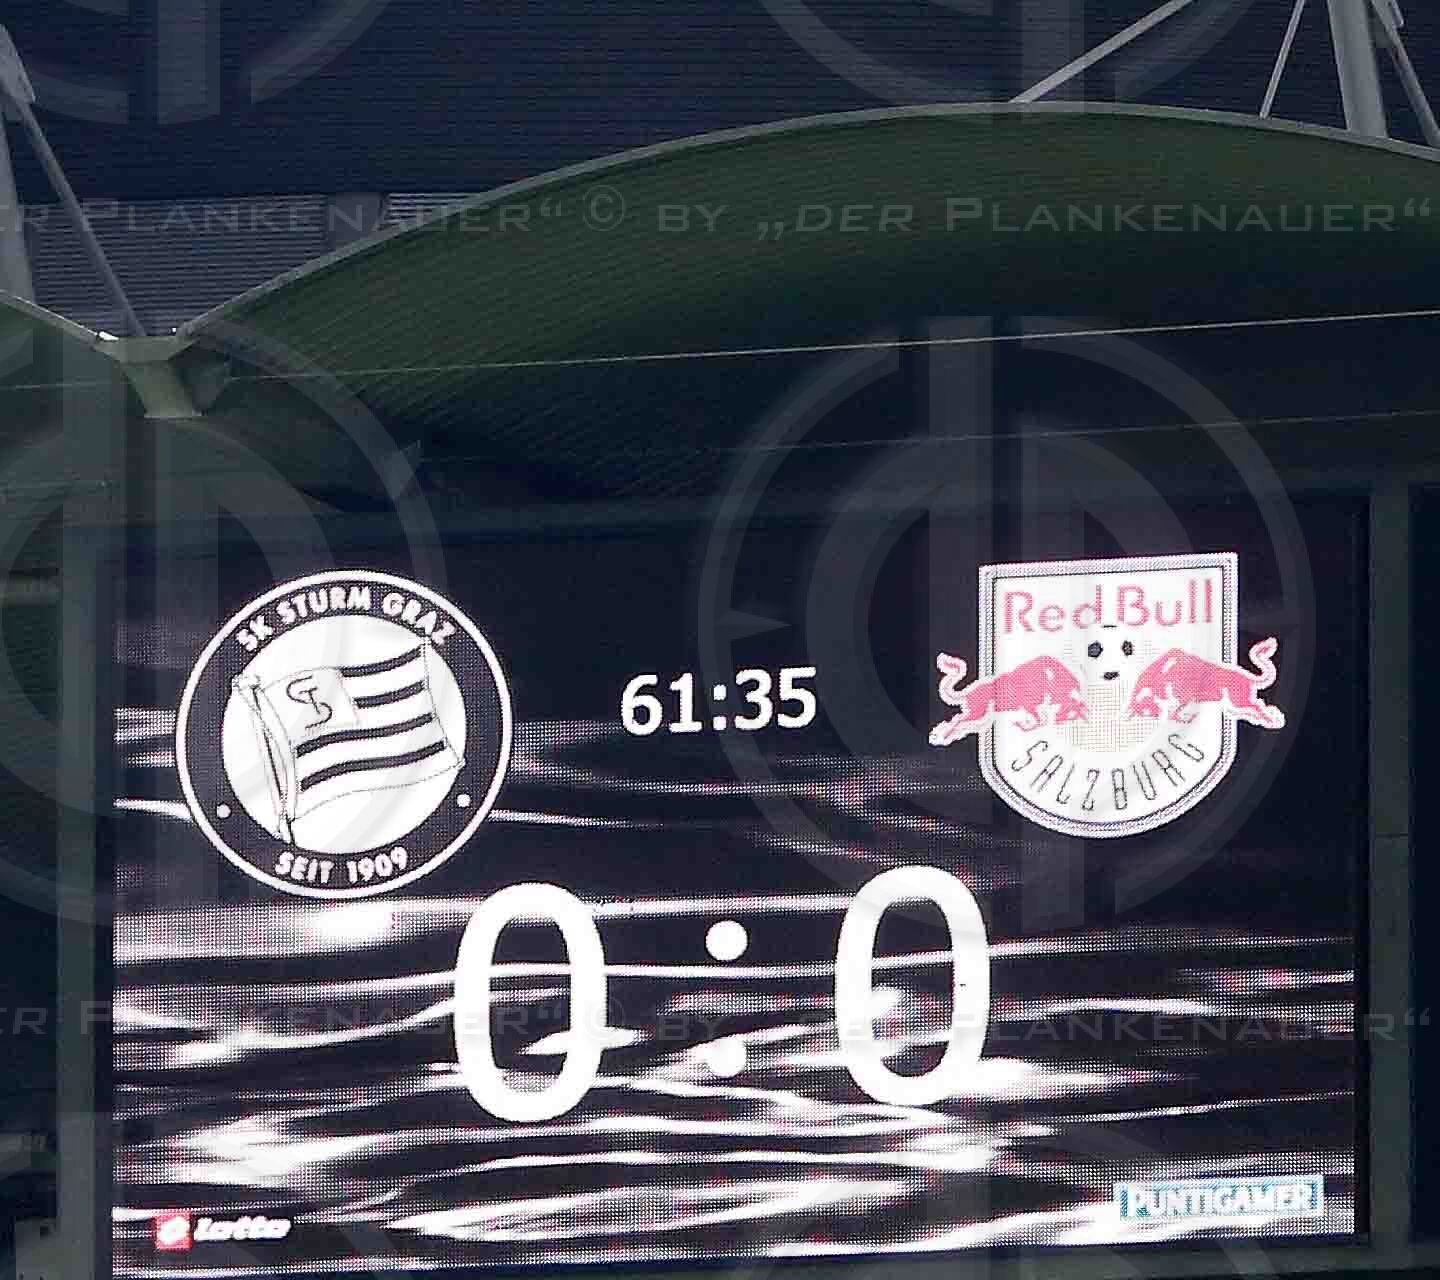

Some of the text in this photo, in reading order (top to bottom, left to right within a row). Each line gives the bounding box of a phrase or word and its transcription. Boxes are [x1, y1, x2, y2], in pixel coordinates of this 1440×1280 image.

[236, 586, 458, 651] SK STURM GRAZ
[1004, 578, 1213, 634] Red Bull
[620, 667, 818, 738] 61:35
[1010, 733, 1205, 812] SALZBURG
[274, 847, 409, 885] SEIT 1909
[1126, 1181, 1313, 1219] PUNTIGAMER
